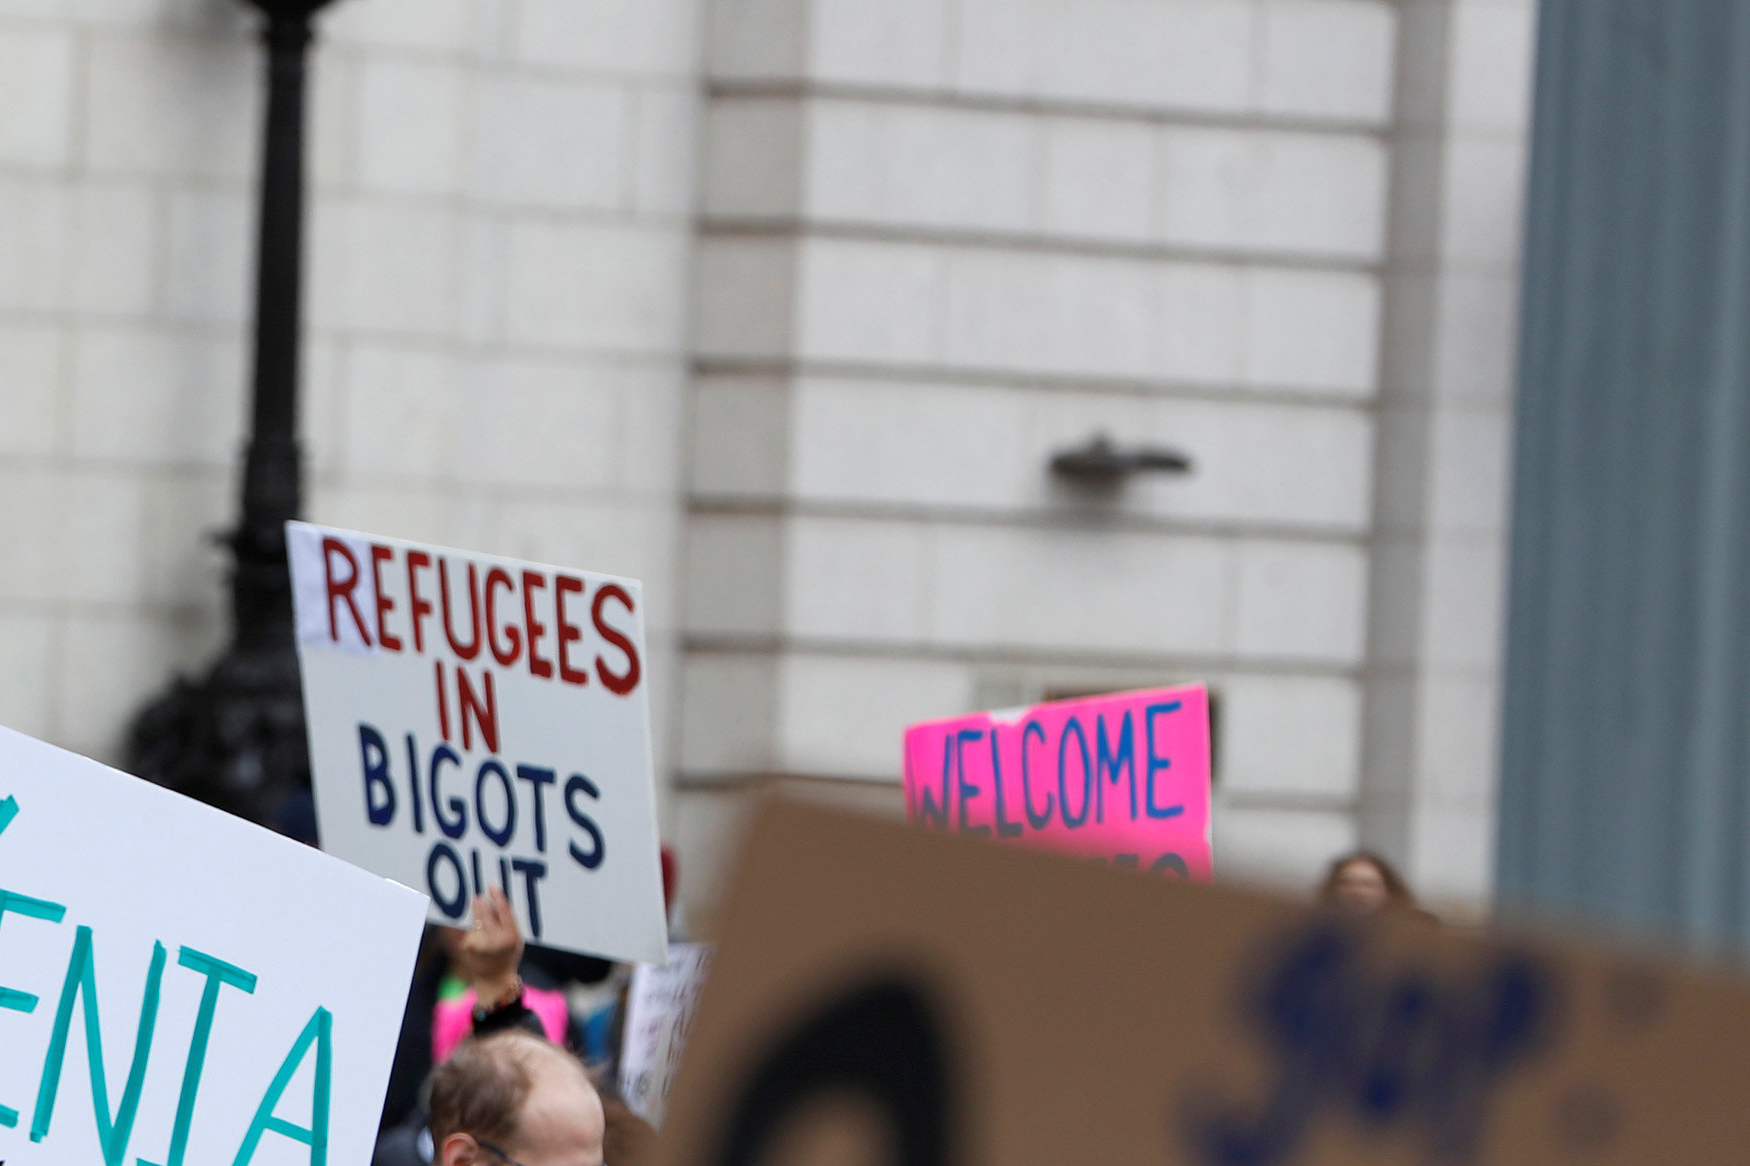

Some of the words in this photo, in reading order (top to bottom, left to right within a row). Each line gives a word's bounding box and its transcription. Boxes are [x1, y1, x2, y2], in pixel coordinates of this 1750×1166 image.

[322, 536, 641, 695] REFUGEES
[435, 659, 499, 753] IN
[906, 700, 1186, 840] WELCOME
[357, 722, 606, 870] BIGOTS
[426, 841, 548, 939] OUT
